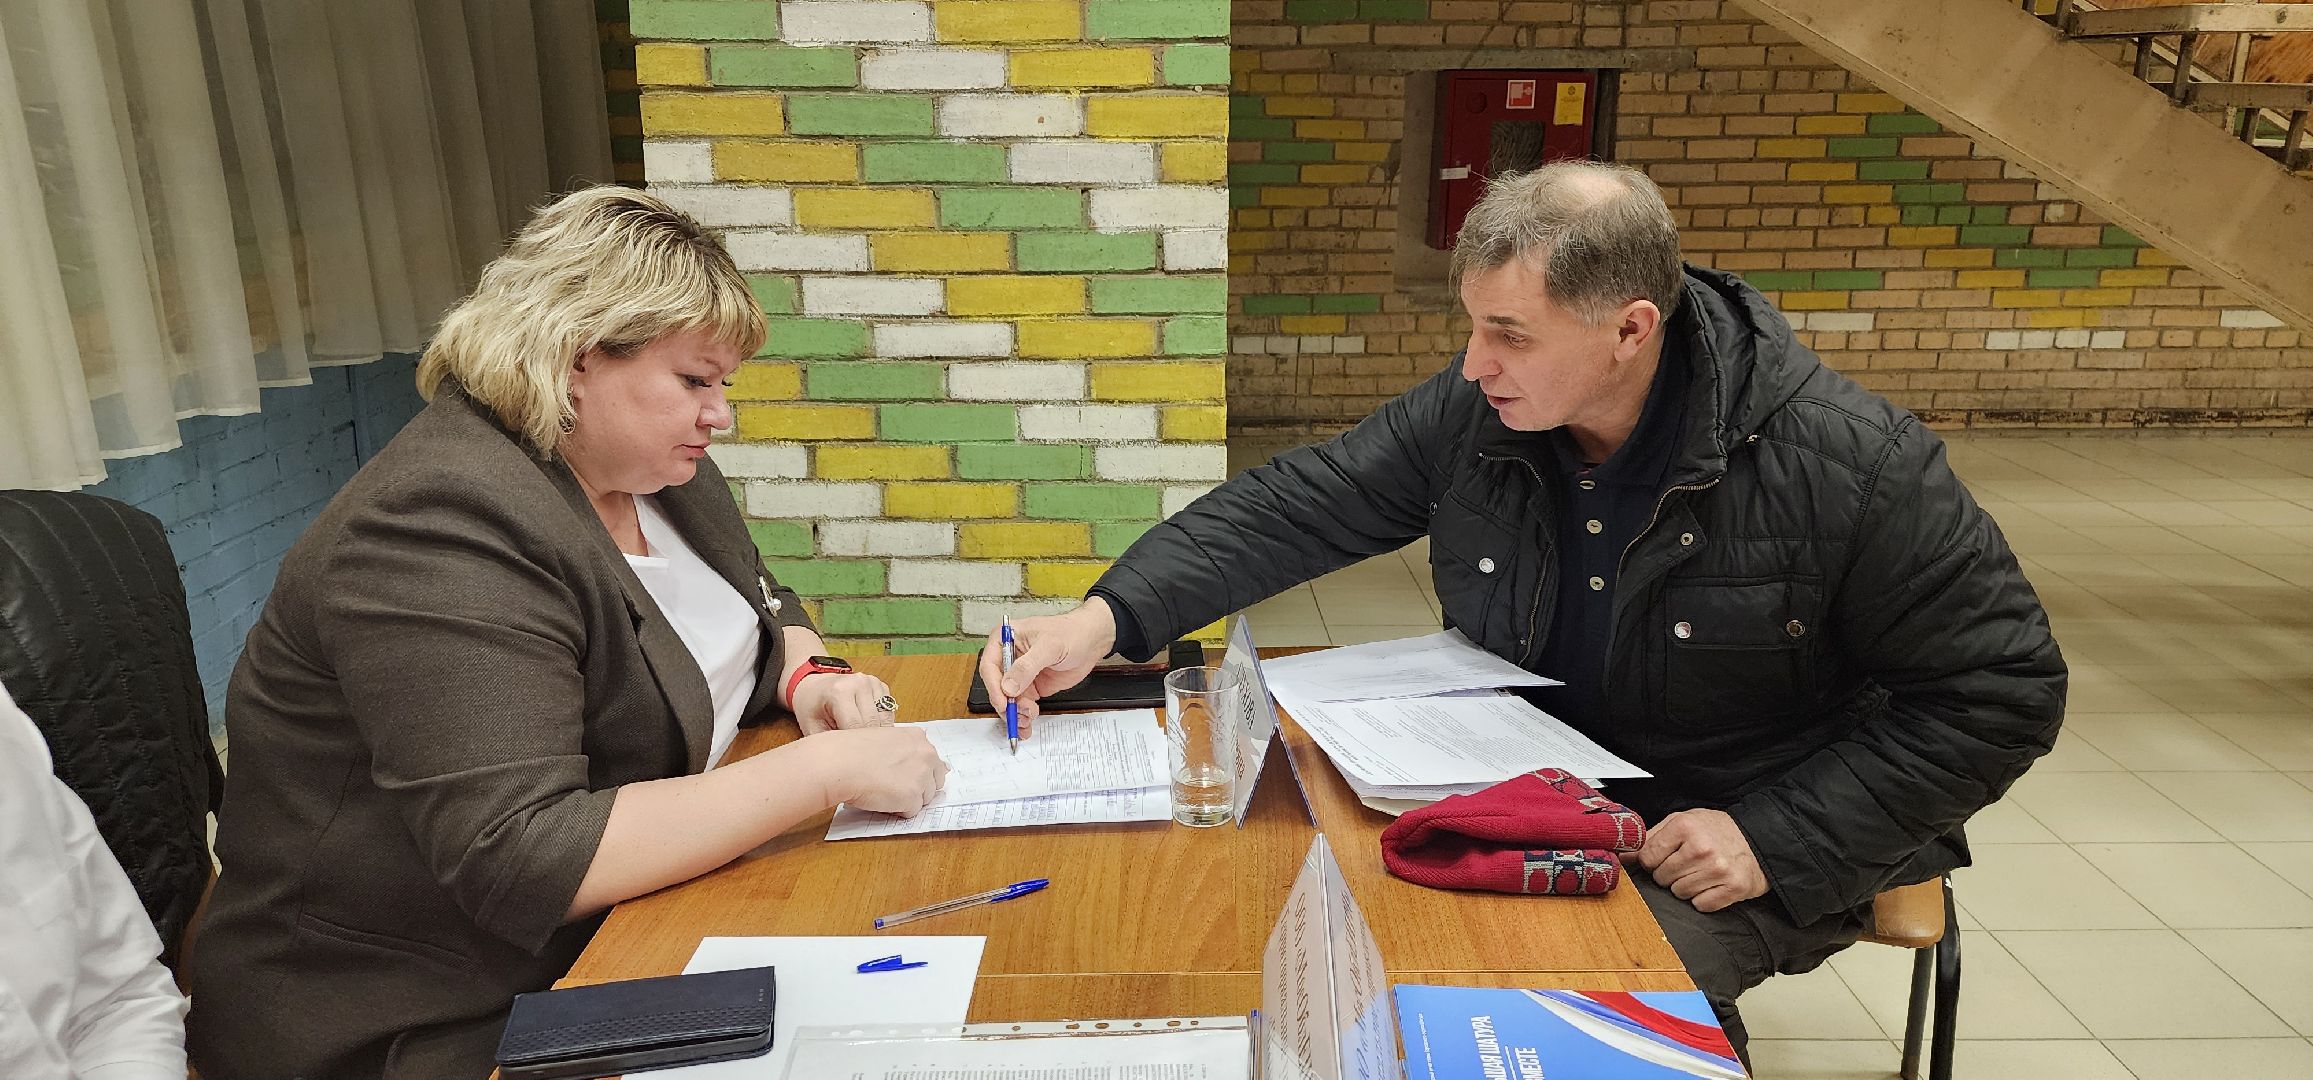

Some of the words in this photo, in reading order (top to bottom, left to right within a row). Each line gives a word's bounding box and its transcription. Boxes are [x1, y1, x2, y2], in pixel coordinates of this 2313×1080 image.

[1295, 892, 1306, 948] ООО
[1471, 1015, 1500, 1055] ШАТУРА
[1481, 1056, 1508, 1080] ШАЯ
[1514, 1048, 1545, 1080] МЕСТЕ
